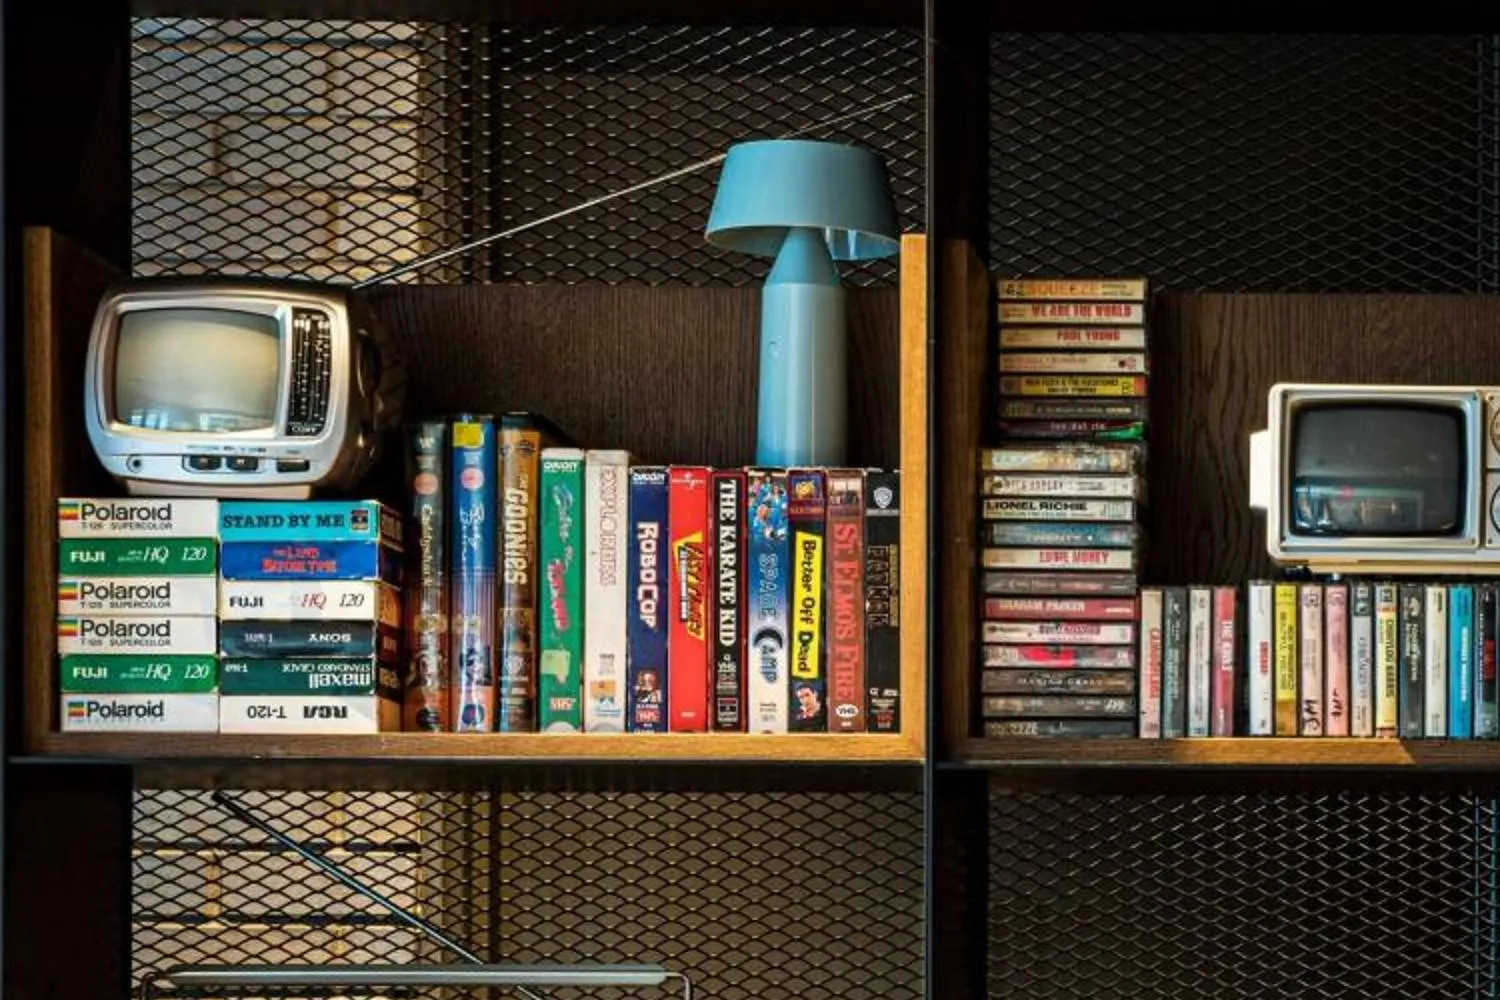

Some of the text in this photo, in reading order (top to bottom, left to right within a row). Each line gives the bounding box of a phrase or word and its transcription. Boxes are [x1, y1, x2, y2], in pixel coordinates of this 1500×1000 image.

[81, 504, 172, 521] Polaroid
[986, 502, 1037, 511] LIONEL
[223, 515, 345, 528] STAND BY ME
[600, 466, 617, 586] EXPLORERS
[71, 551, 104, 562] FUJI
[181, 548, 206, 560] 120
[720, 479, 736, 646] THE KARATE KID
[801, 540, 816, 592] Better
[80, 582, 171, 599] Polaroid
[230, 597, 263, 607] FUJI
[339, 594, 364, 607] 120
[799, 597, 814, 624] Off
[80, 620, 171, 636] Polaroid
[73, 668, 108, 678] FUJI
[184, 665, 209, 678] 120
[835, 645, 858, 701] FIRE
[309, 674, 370, 687] maxell
[88, 701, 163, 718] Polaroid
[248, 706, 346, 718] RCA T-120
